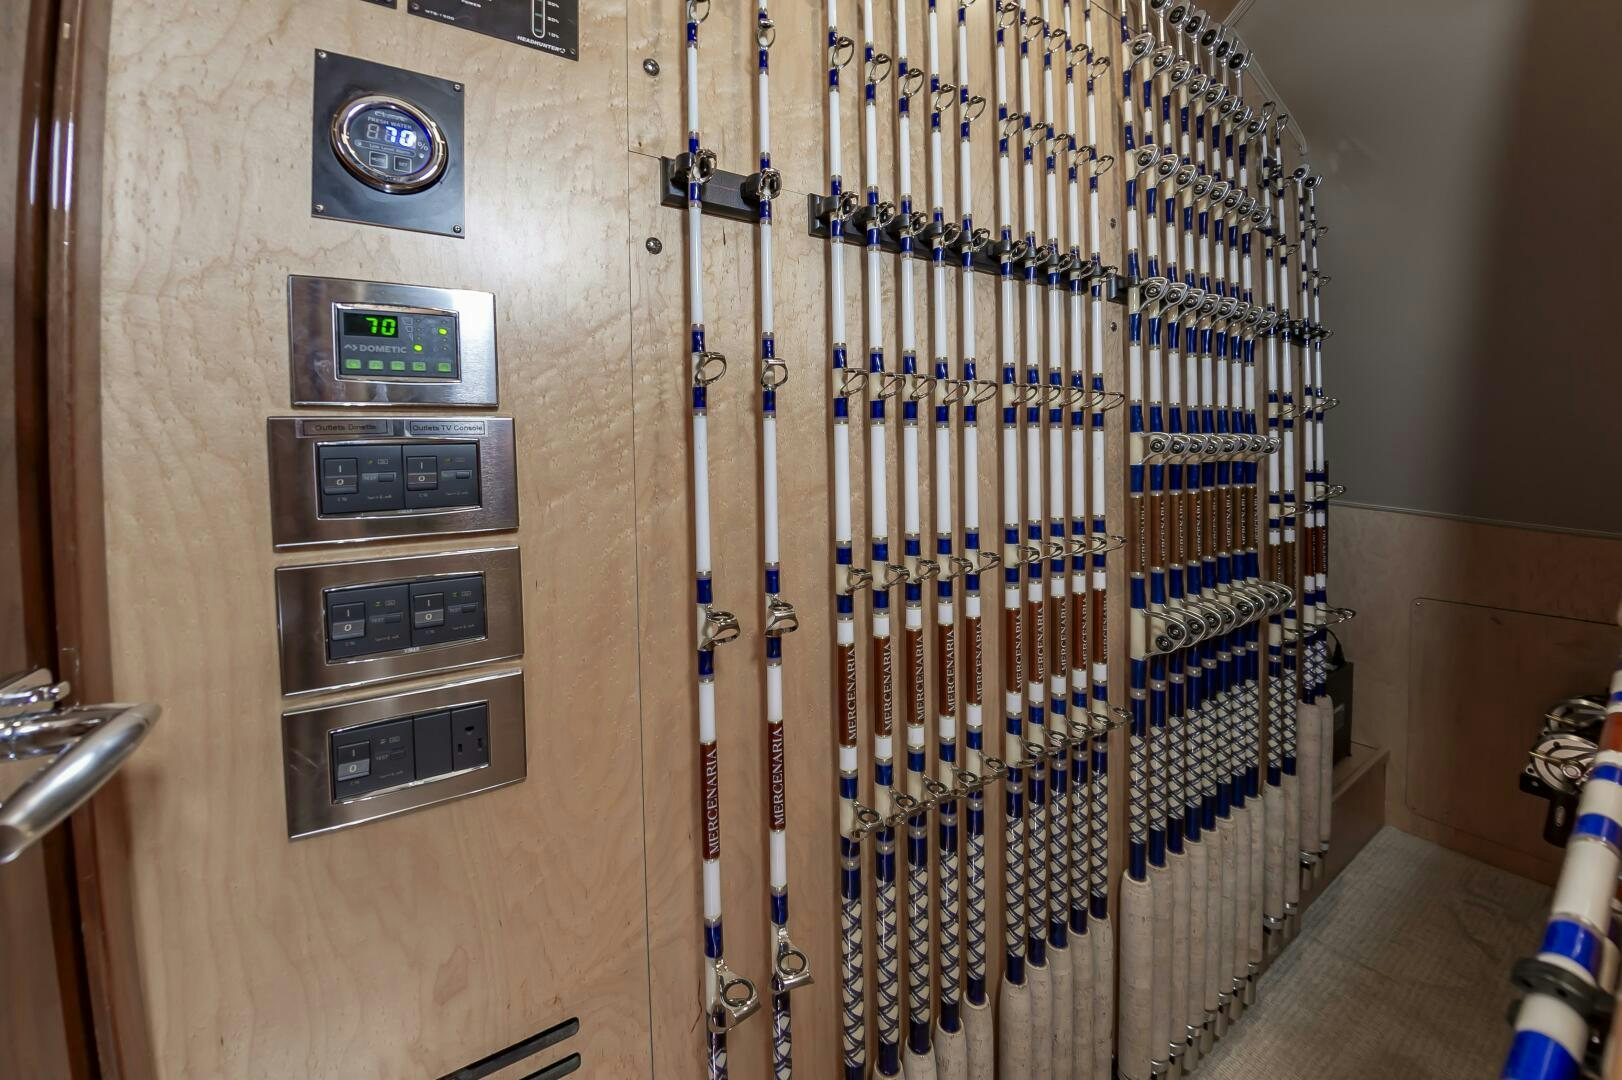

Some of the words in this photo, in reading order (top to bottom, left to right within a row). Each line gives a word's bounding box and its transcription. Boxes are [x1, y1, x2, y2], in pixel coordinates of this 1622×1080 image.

[517, 35, 561, 52] HEADHUNTER
[368, 116, 389, 124] FRESH
[360, 344, 407, 354] DOMETIC
[366, 317, 397, 336] 70
[412, 424, 440, 432] Outlets
[440, 424, 452, 432] TV
[453, 424, 483, 432] Console
[848, 648, 857, 740] MERCENARIA
[884, 642, 892, 731] MERCENARIA
[916, 634, 925, 721] MERCENARIA
[947, 630, 956, 713] MERCENARIA
[706, 748, 720, 854] MERCENARIA
[772, 726, 785, 826] MERCENARIA
